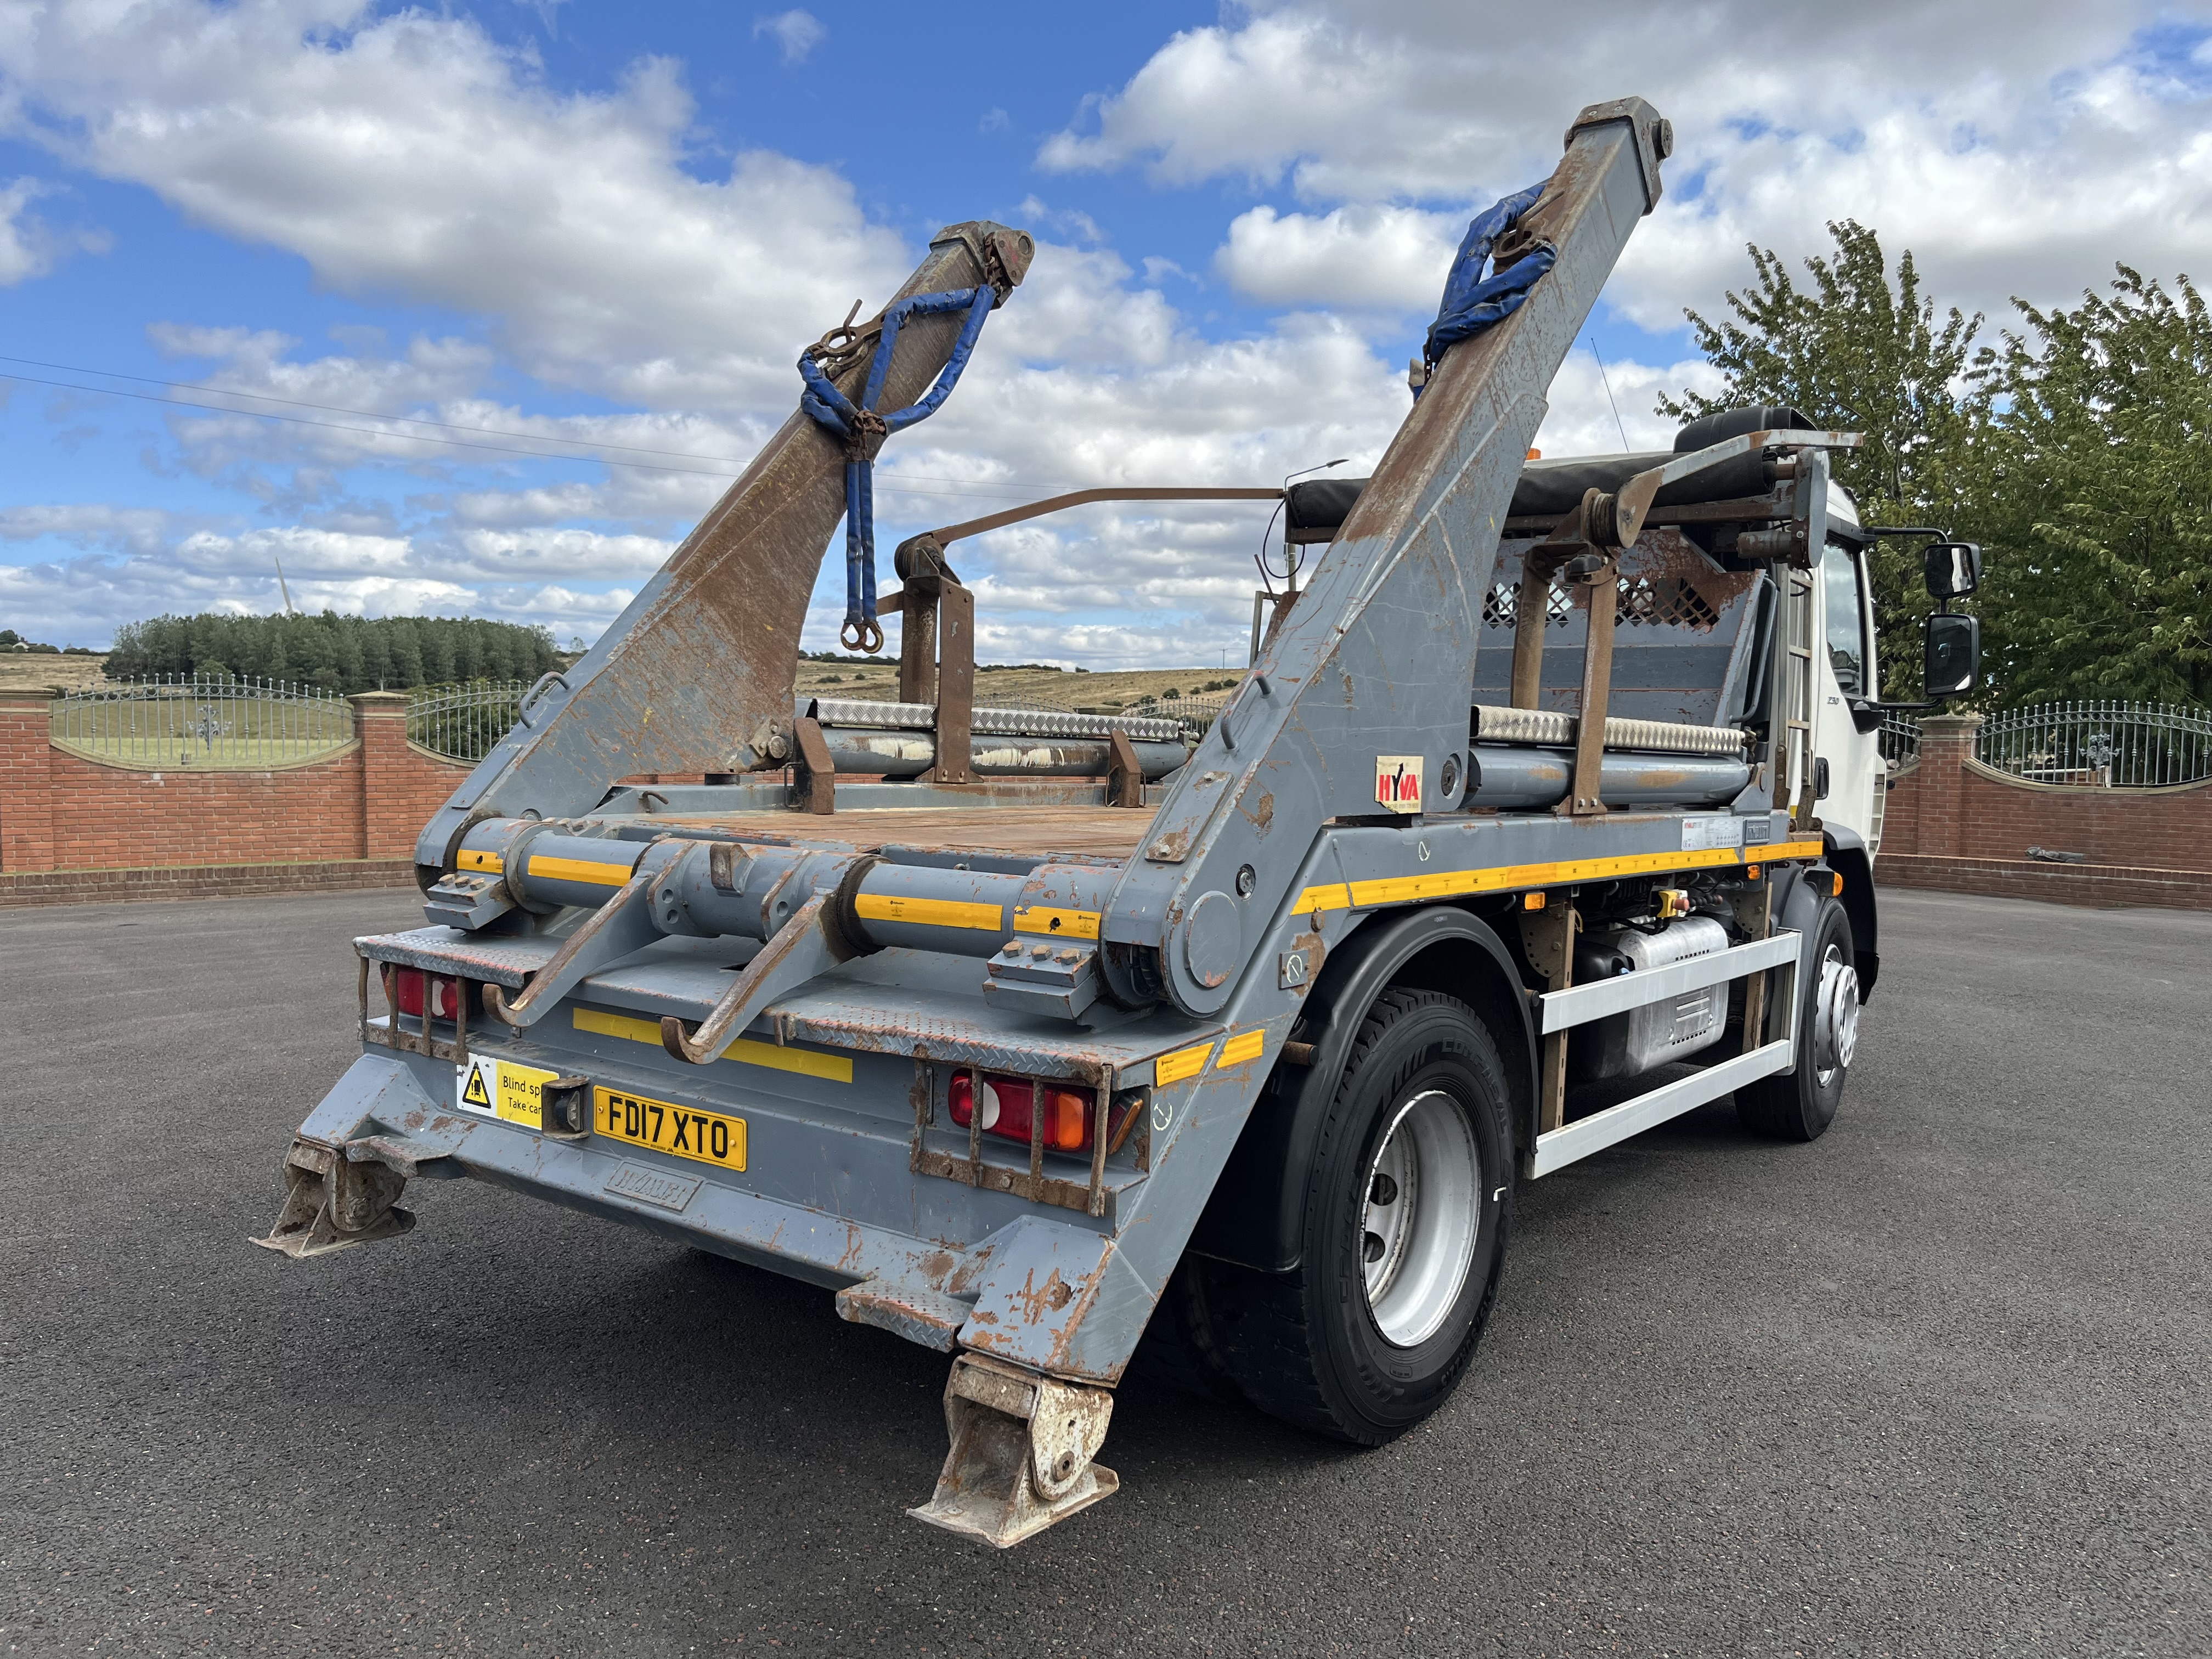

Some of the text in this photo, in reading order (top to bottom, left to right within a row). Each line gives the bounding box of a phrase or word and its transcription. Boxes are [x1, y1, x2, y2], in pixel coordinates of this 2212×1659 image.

[1379, 763, 1419, 801] HYVA
[503, 1076, 540, 1099] Blind sp
[1442, 1037, 1507, 1135] COMPASAL
[508, 1097, 541, 1115] Take car
[609, 1096, 729, 1159] FD17 XTO
